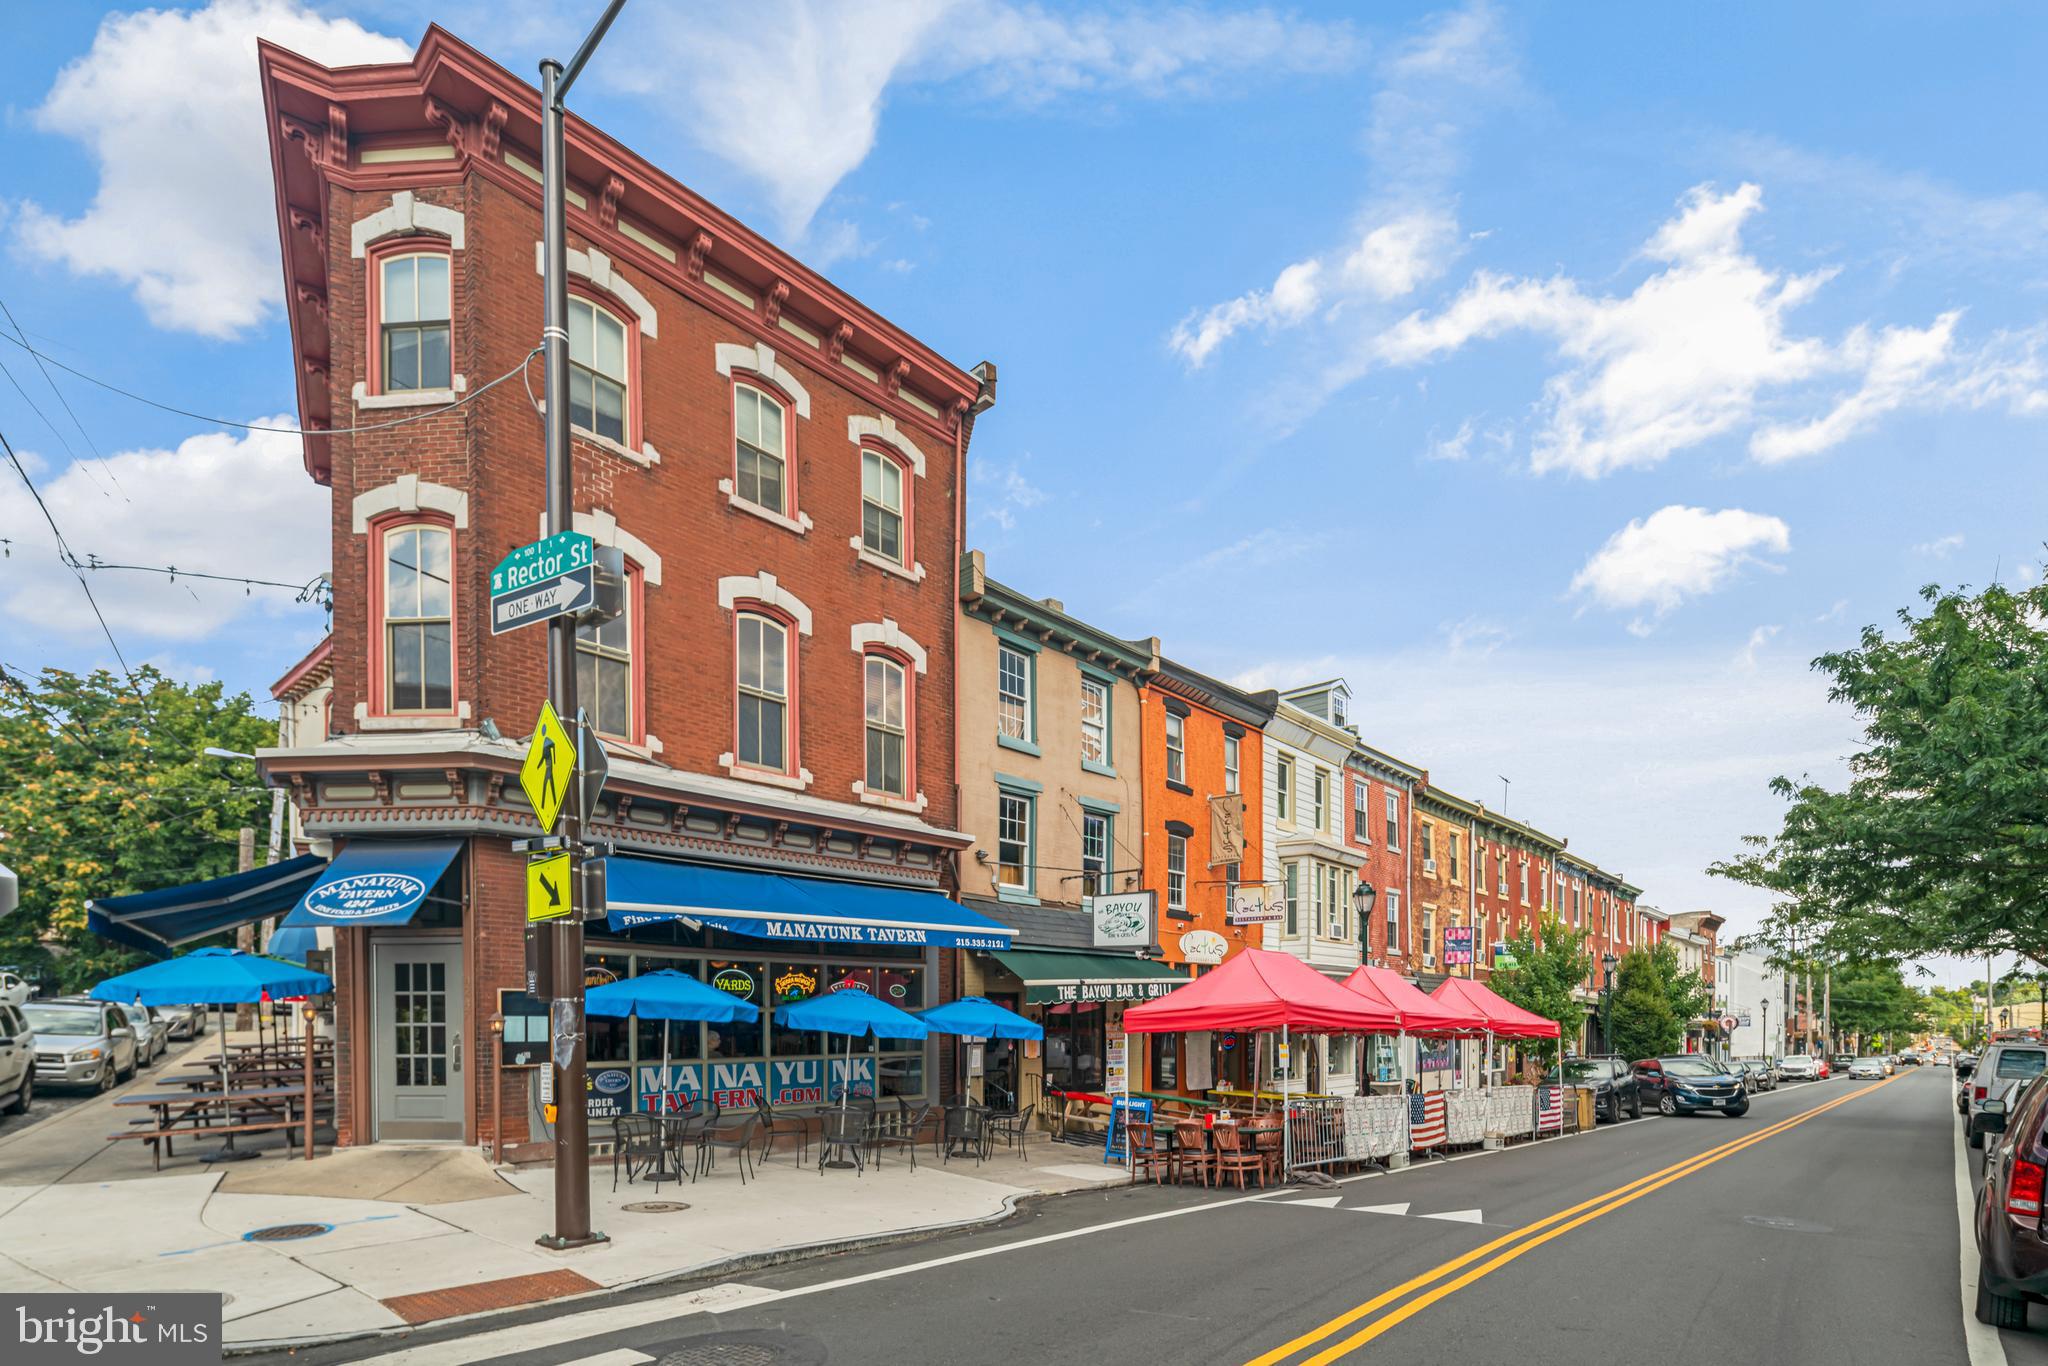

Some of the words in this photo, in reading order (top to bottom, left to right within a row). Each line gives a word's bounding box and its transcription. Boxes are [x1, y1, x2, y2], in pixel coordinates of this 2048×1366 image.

[508, 553, 563, 589] Rector
[571, 540, 588, 567] St
[508, 598, 529, 617] ONE
[535, 589, 557, 608] WAY
[317, 876, 419, 899] MANAYUNK
[338, 889, 398, 899] TAVERN
[1105, 902, 1142, 915] BAYOU
[1234, 896, 1284, 915] Cactus
[766, 921, 863, 941] MANAYUNK
[867, 927, 927, 943] TAVERN
[1184, 933, 1223, 956] Cactus
[716, 978, 751, 991] YARDS
[1057, 985, 1077, 1000] THE
[1082, 984, 1112, 999] BAYOU
[1116, 983, 1134, 998] BAR
[1138, 984, 1144, 996] &
[640, 1066, 701, 1093] MA
[713, 1063, 763, 1089] NA
[775, 1060, 817, 1085] YU
[588, 1097, 614, 1108] RDER
[712, 1087, 763, 1109] ERN
[587, 1107, 609, 1118] LINE
[610, 1106, 622, 1116] AT
